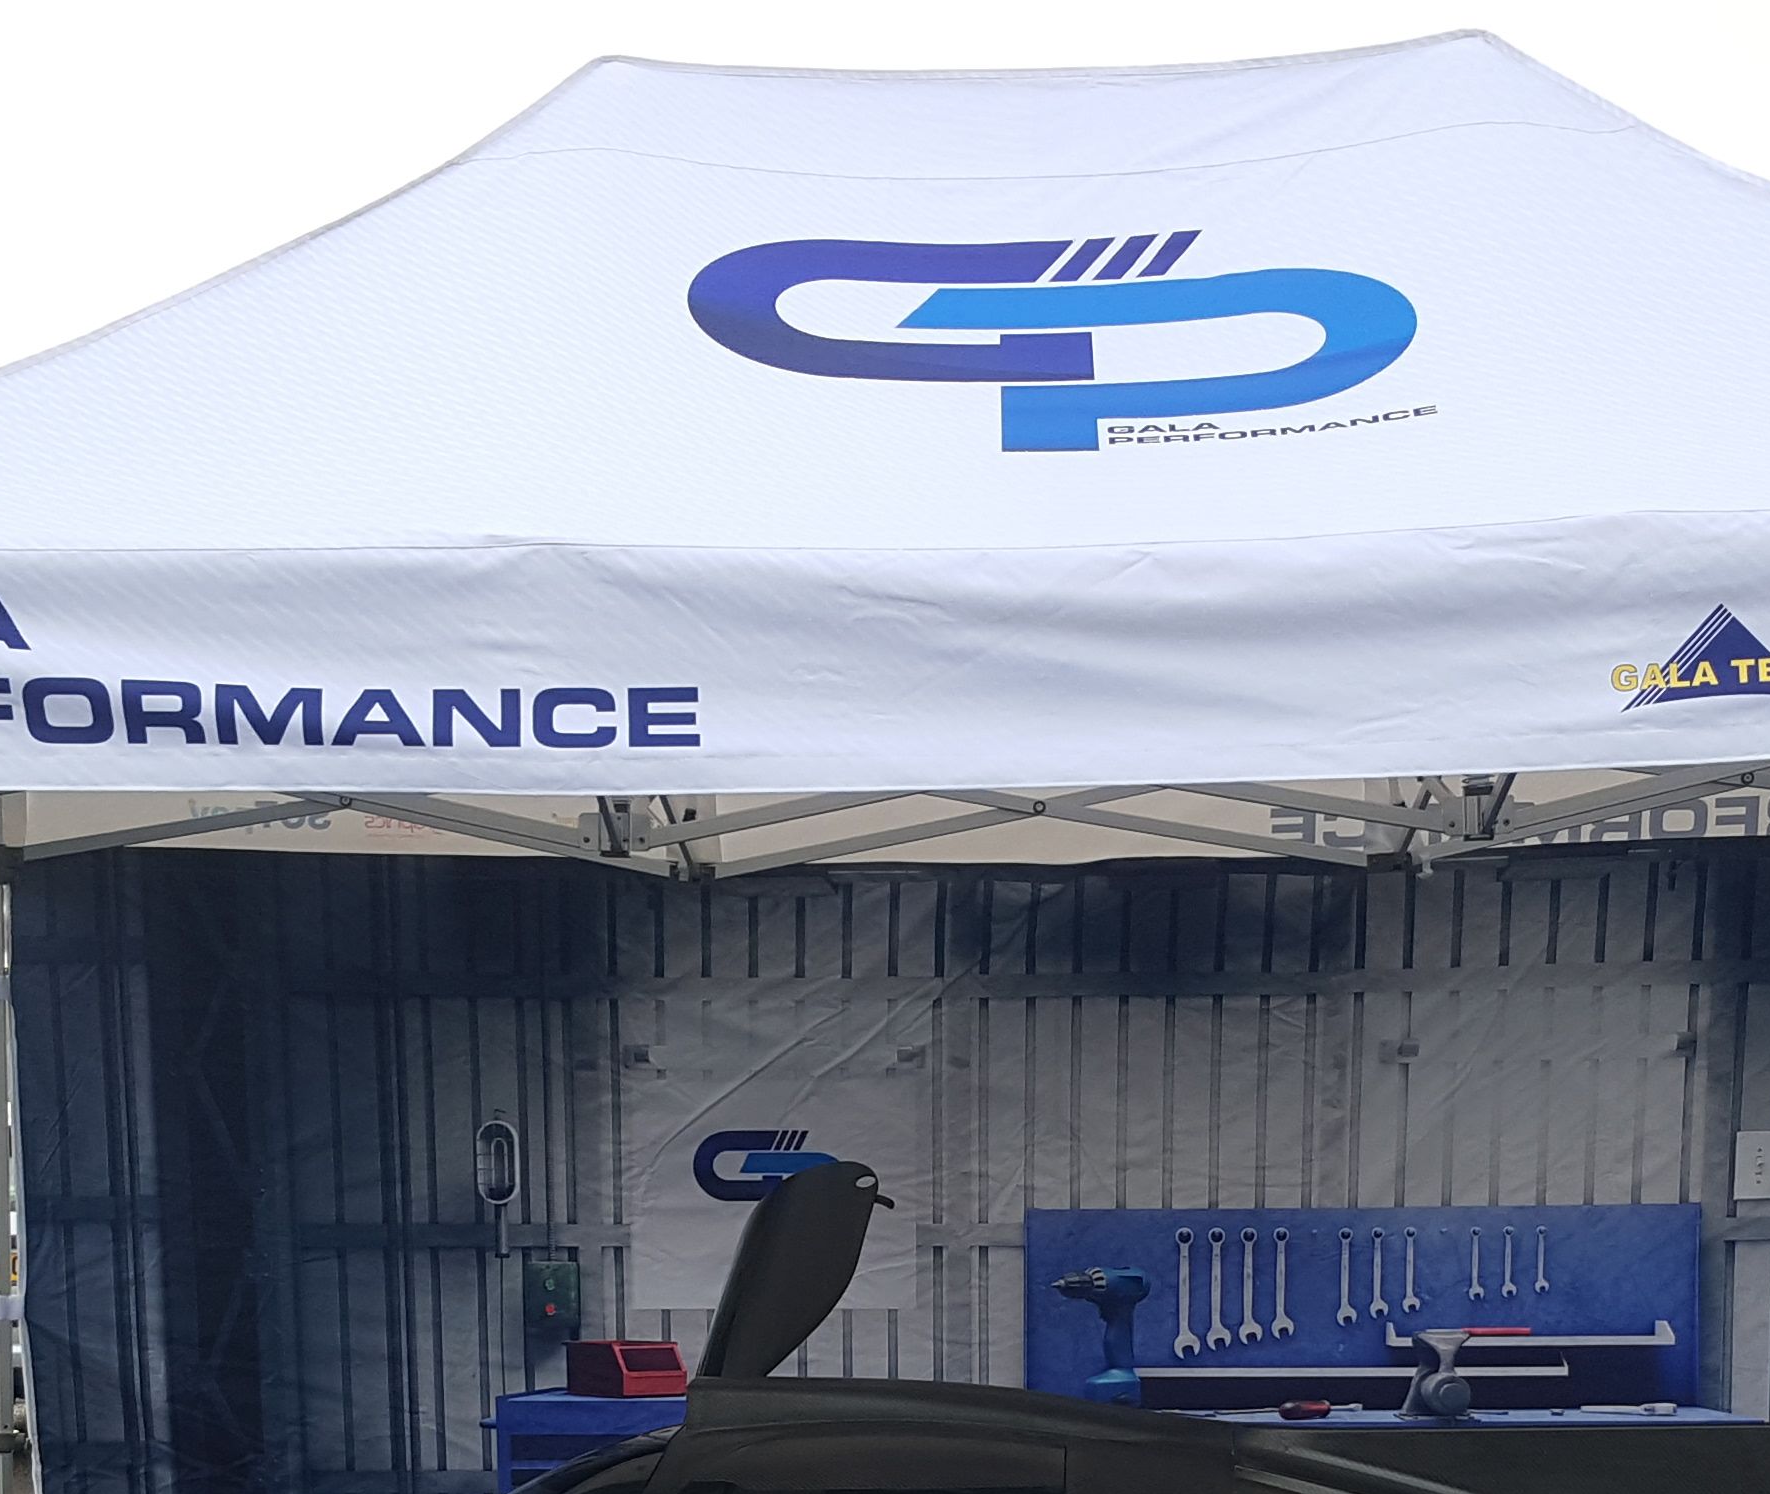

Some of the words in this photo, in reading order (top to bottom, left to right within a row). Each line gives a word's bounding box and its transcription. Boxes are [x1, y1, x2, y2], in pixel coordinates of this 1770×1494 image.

[1107, 422, 1220, 434] GALA
[1108, 404, 1439, 444] PERFORMANCE
[1611, 661, 1719, 692] GALA
